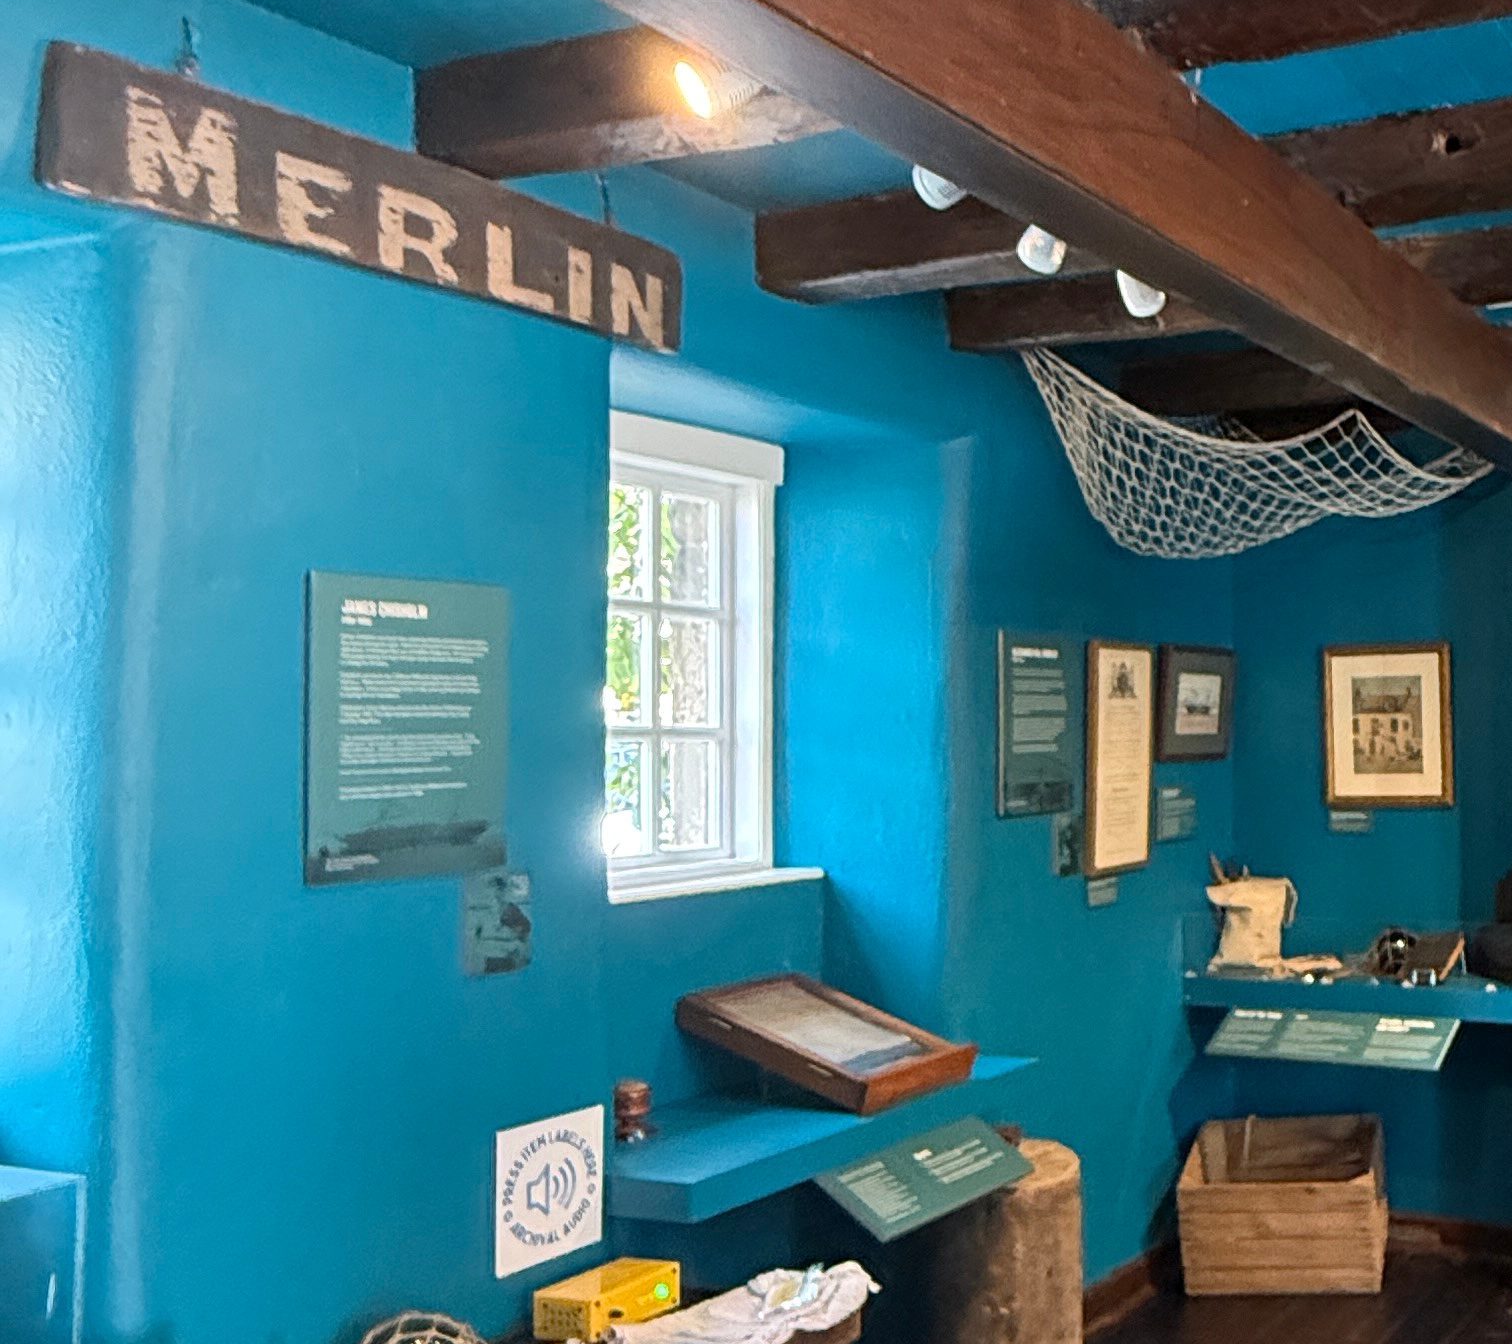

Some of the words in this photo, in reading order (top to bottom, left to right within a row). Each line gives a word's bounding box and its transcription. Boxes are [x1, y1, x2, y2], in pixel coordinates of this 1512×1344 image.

[124, 84, 670, 348] MERLIN
[502, 1159, 525, 1206] PRESS
[520, 1133, 547, 1162] ITEM
[547, 1129, 586, 1150] LABELS
[563, 1197, 591, 1236] AUDIO
